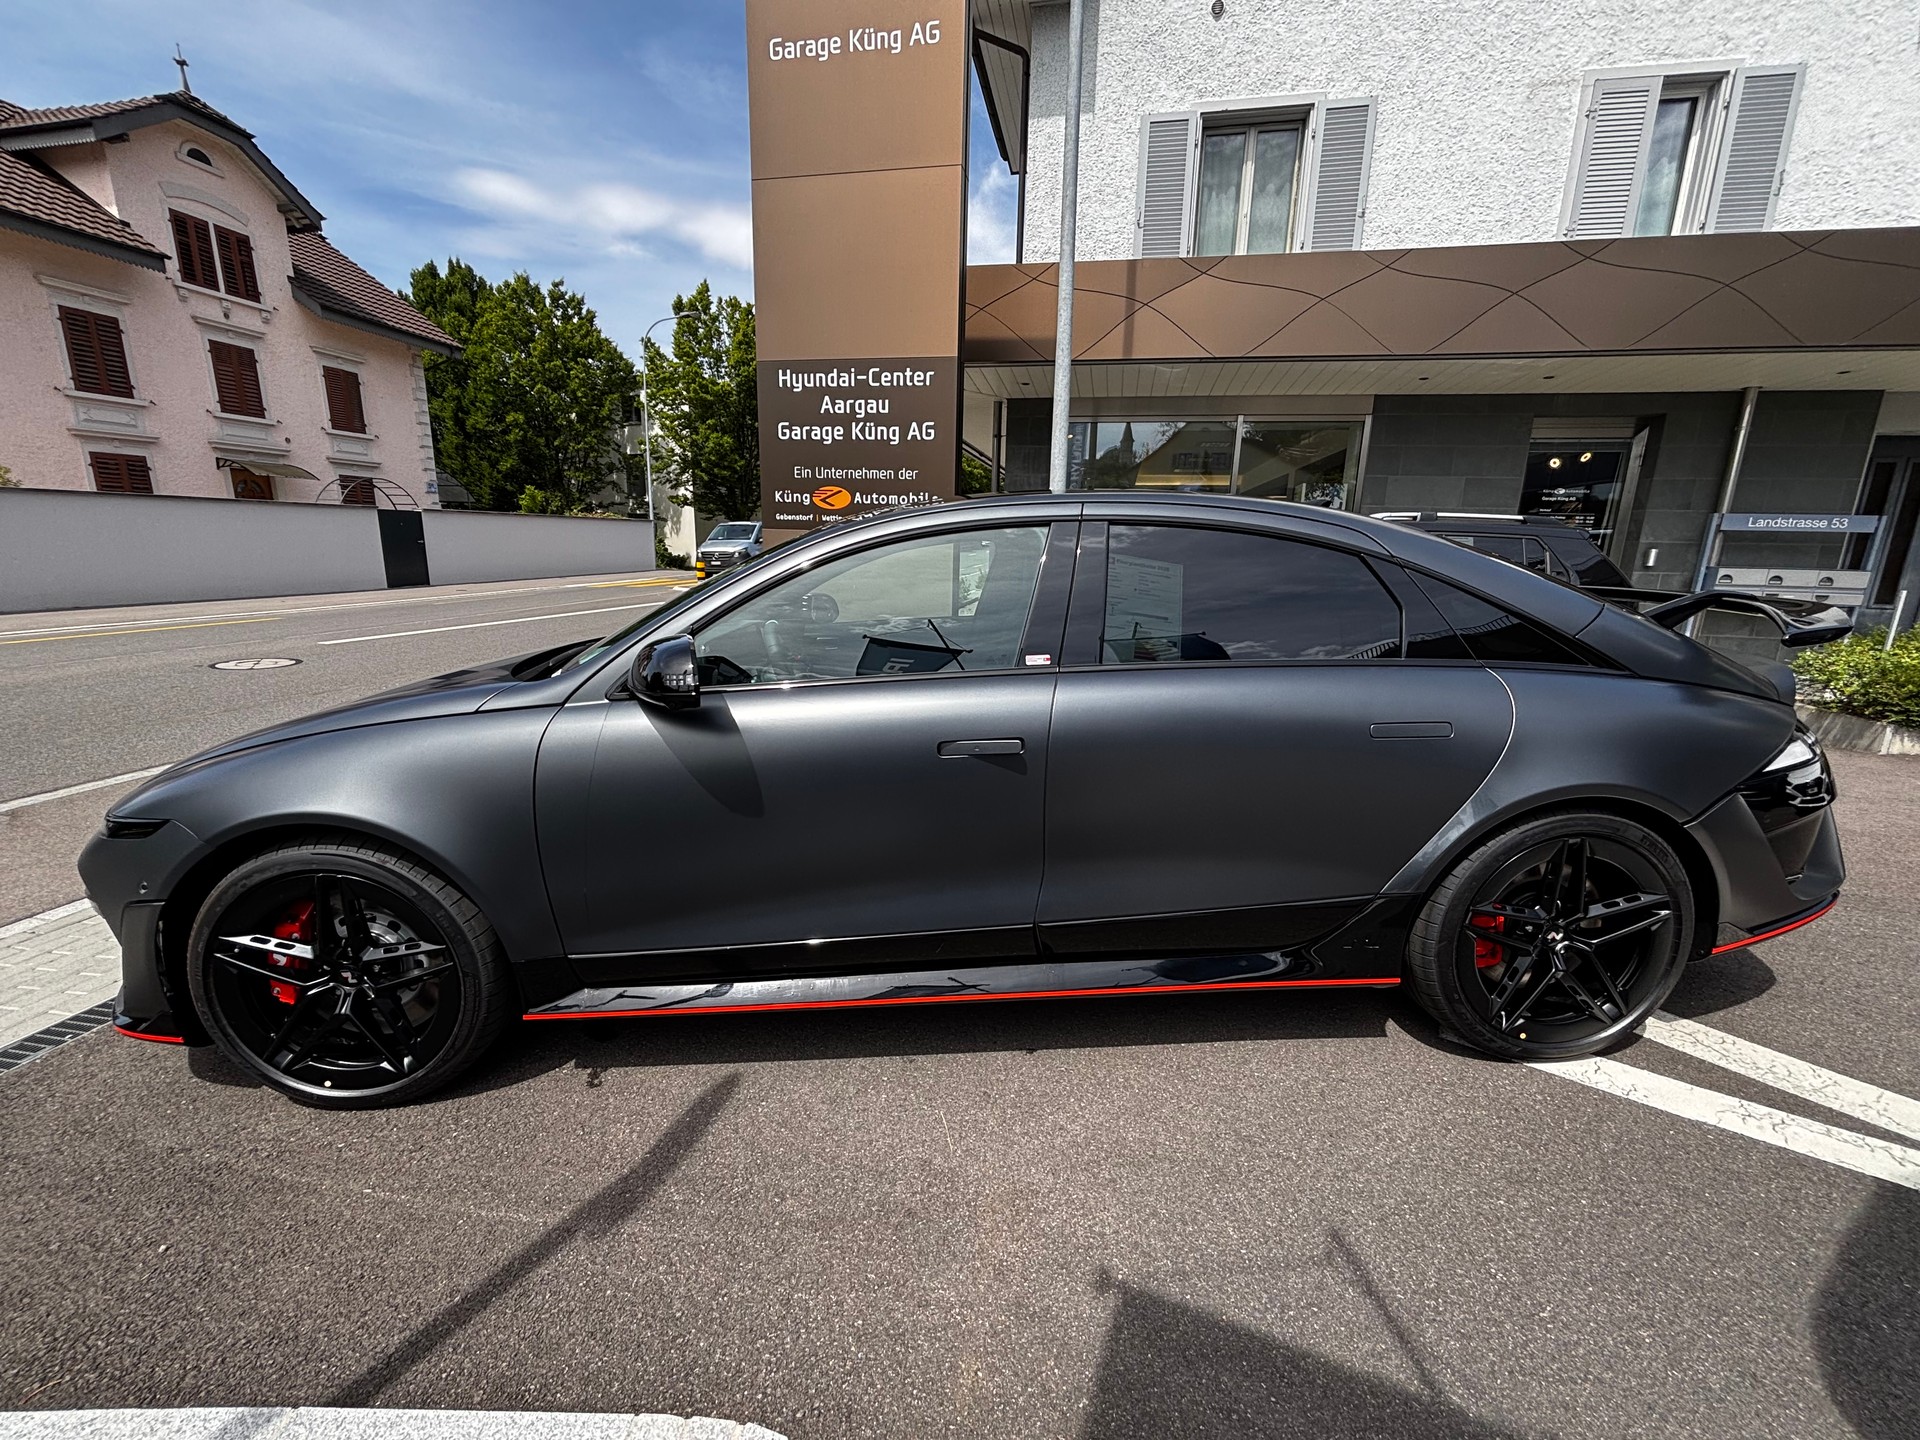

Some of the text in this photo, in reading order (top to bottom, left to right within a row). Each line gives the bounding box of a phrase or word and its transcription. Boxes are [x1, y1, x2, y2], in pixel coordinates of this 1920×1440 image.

[769, 20, 941, 61] Garage Küng AG
[778, 367, 935, 392] Hyundai-Center
[820, 395, 889, 418] Aargau
[777, 421, 935, 445] Garage Küng AG
[794, 466, 919, 480] Ein Unternehmen der
[775, 490, 811, 505] Küng
[775, 513, 814, 521] Gebenstorf
[1748, 517, 1849, 529] Landstrasse 53
